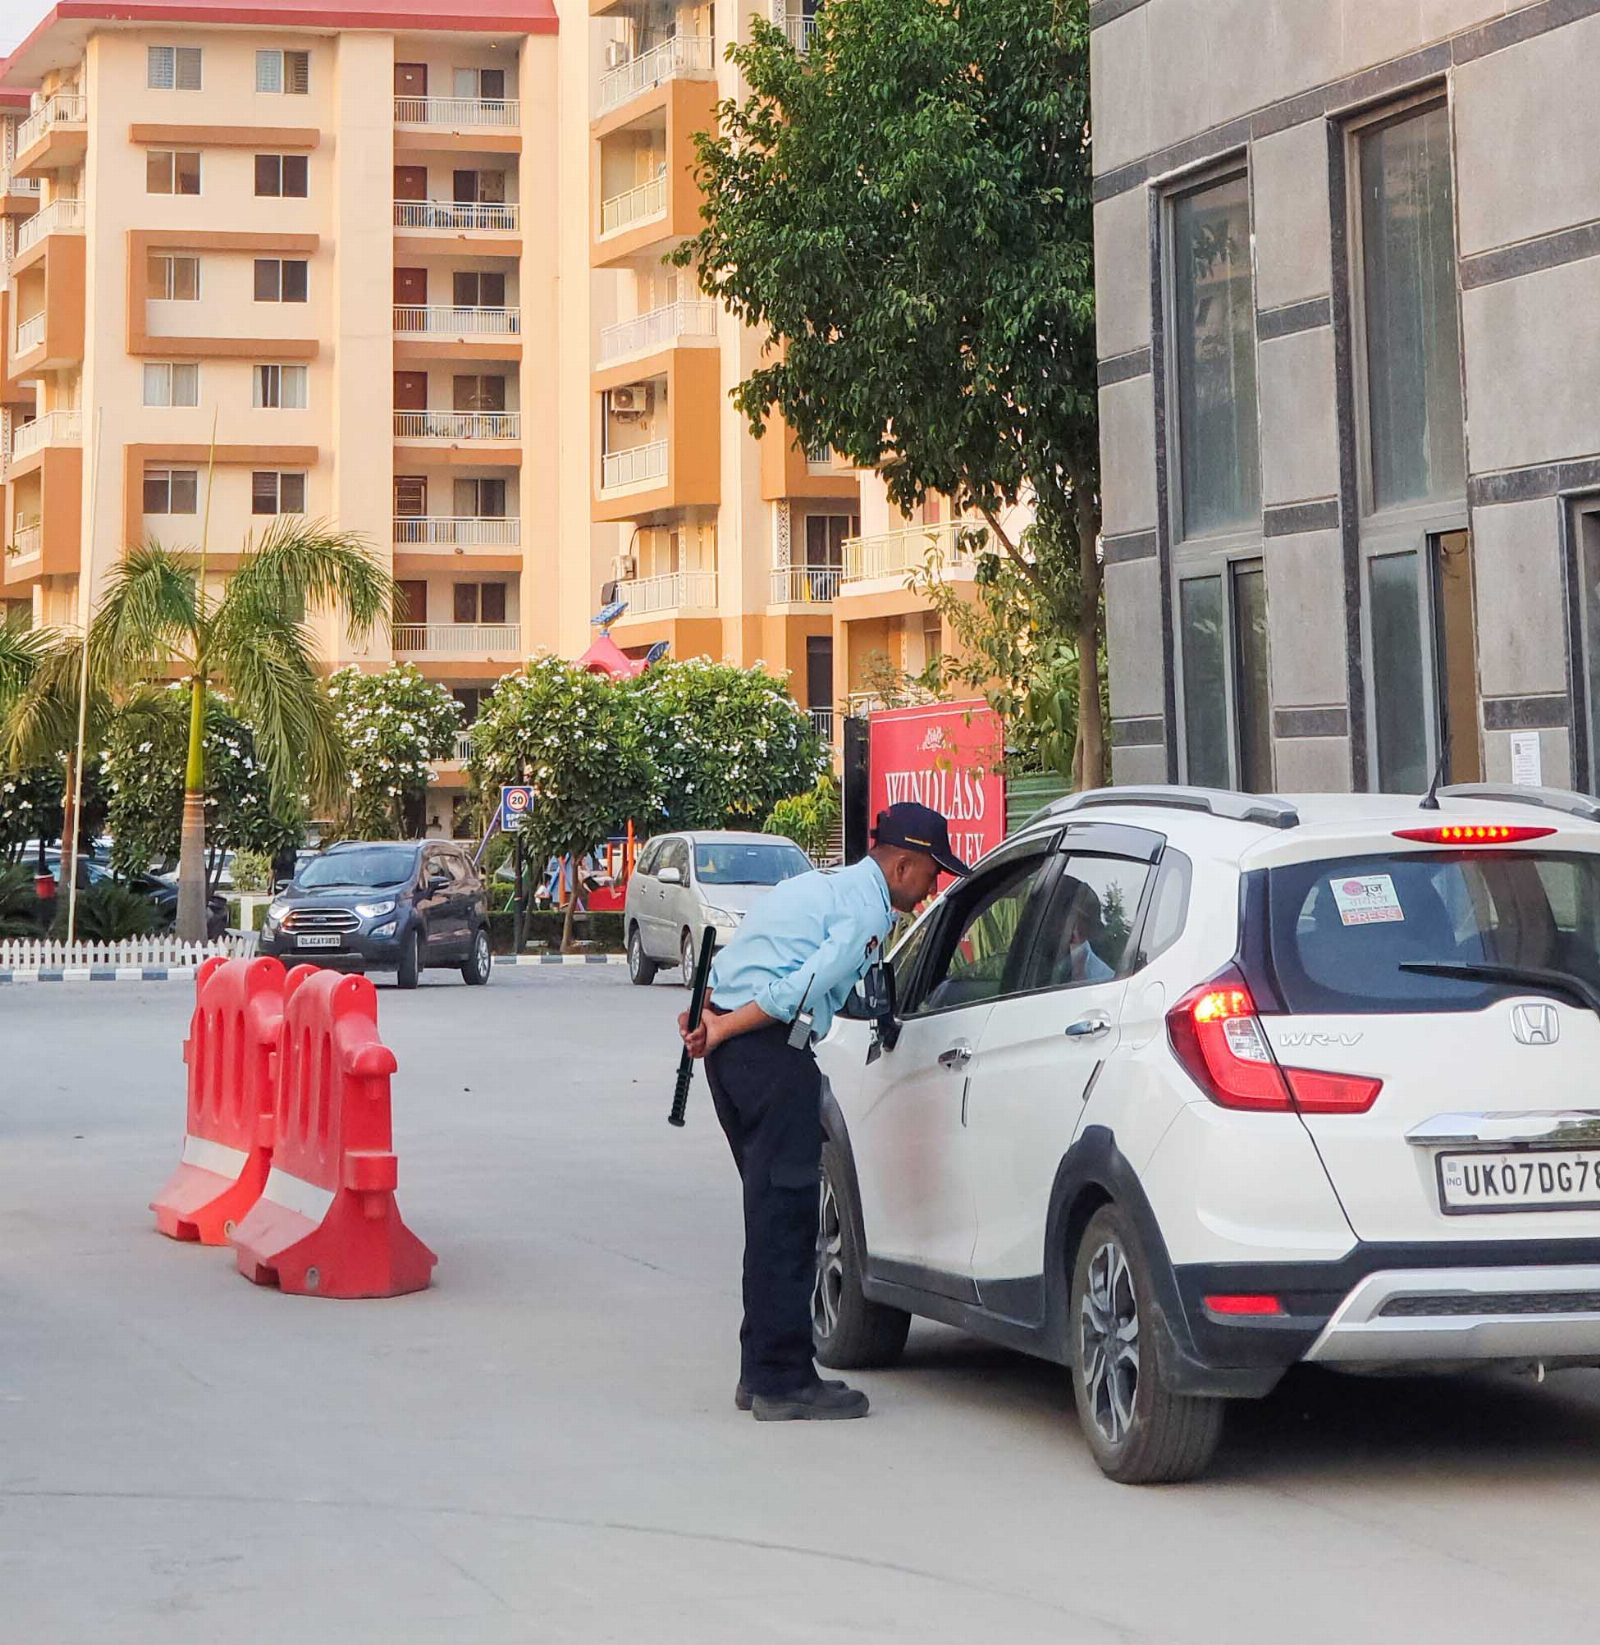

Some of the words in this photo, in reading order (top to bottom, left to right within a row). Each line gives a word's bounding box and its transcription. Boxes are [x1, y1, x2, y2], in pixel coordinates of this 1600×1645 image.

[511, 795, 524, 805] 20
[885, 766, 985, 821] WINDLASS
[1347, 908, 1398, 923] PRESS
[1279, 1031, 1364, 1047] WR-V
